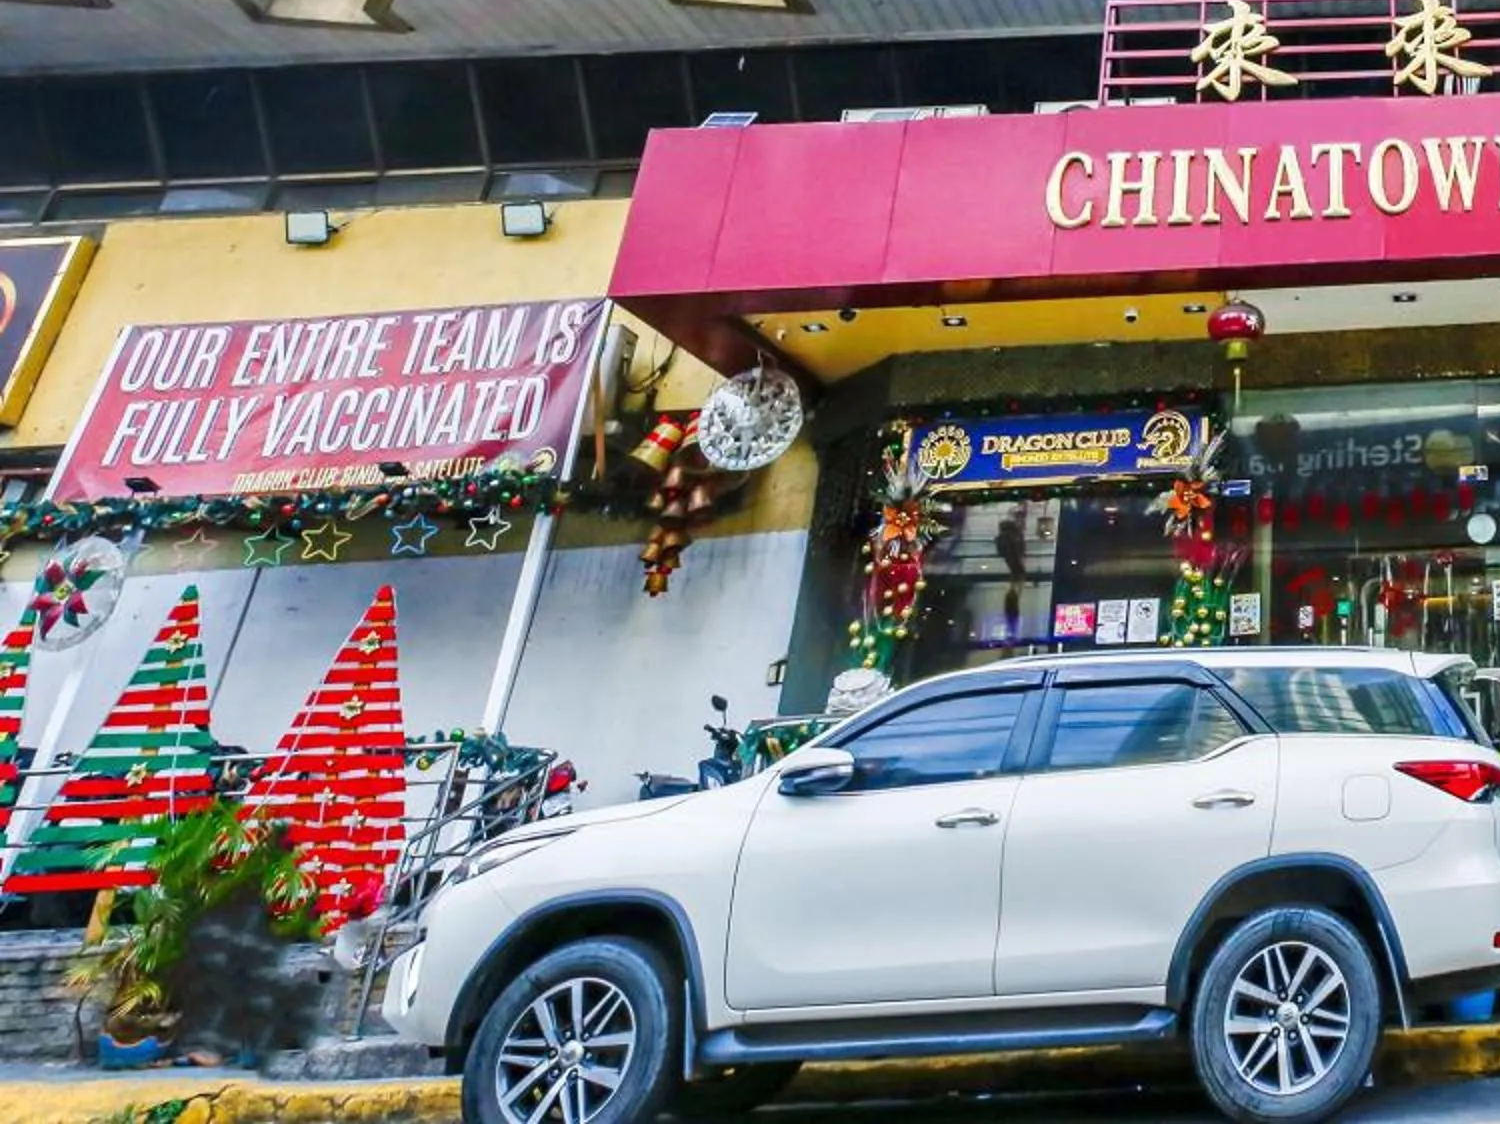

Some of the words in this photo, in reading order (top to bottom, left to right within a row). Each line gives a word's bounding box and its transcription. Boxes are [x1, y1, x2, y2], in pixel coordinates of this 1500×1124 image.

[119, 326, 233, 393] OUR
[231, 314, 400, 388] ENTIRE
[401, 304, 531, 375] TEAM
[534, 300, 589, 366] IS
[100, 393, 261, 468] FULLY
[261, 374, 549, 459] VACCINATED
[981, 432, 1077, 455] DRAGON
[1076, 428, 1132, 448] CLUB
